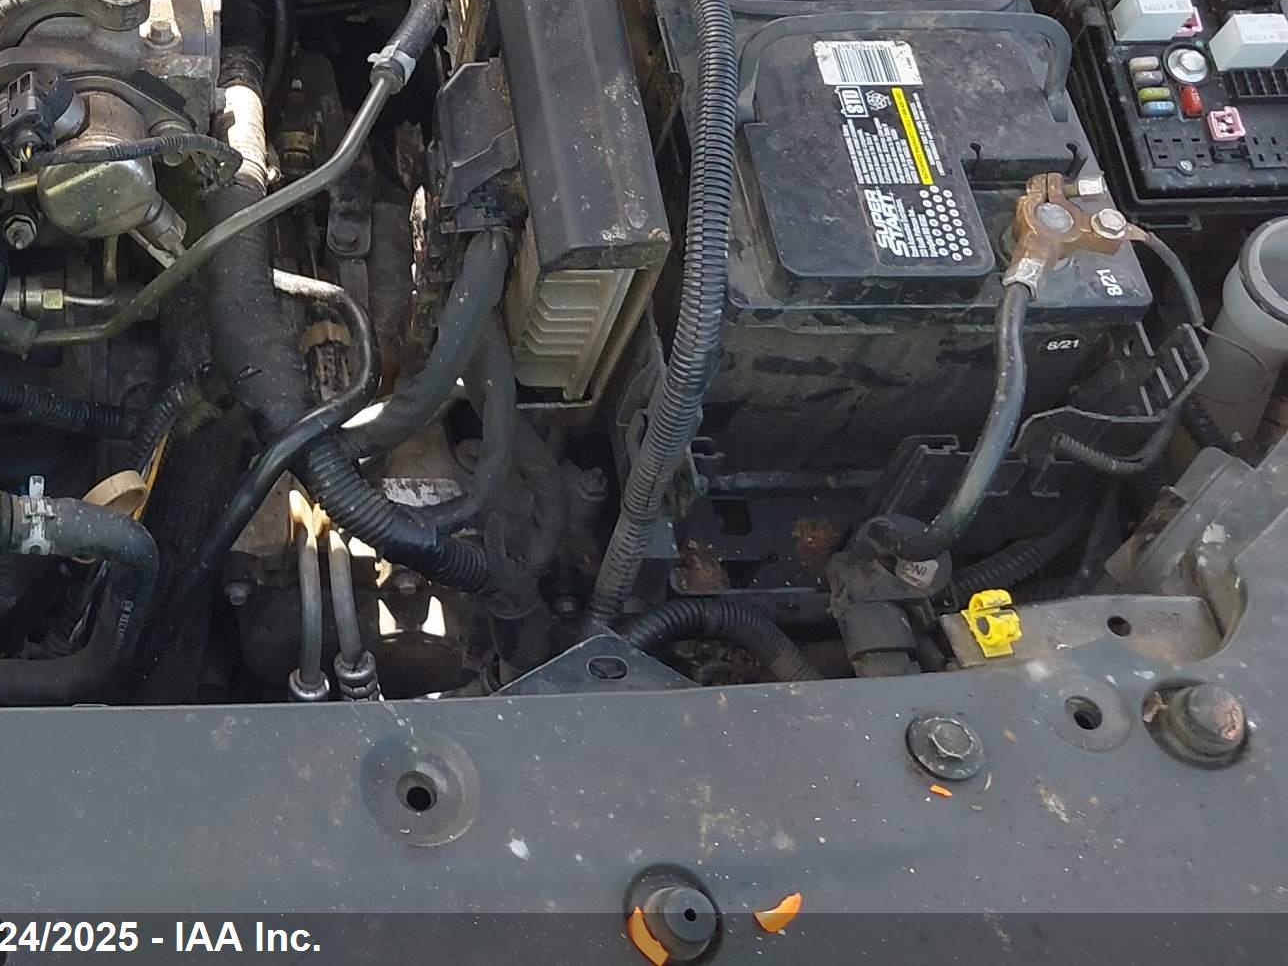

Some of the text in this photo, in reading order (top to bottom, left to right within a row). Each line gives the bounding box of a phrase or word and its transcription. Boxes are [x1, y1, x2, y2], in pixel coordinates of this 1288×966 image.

[841, 89, 864, 114] STD
[864, 189, 888, 248] SUPER
[876, 191, 910, 257] START
[1096, 268, 1123, 296] 8/21
[1046, 339, 1080, 350] 8/21
